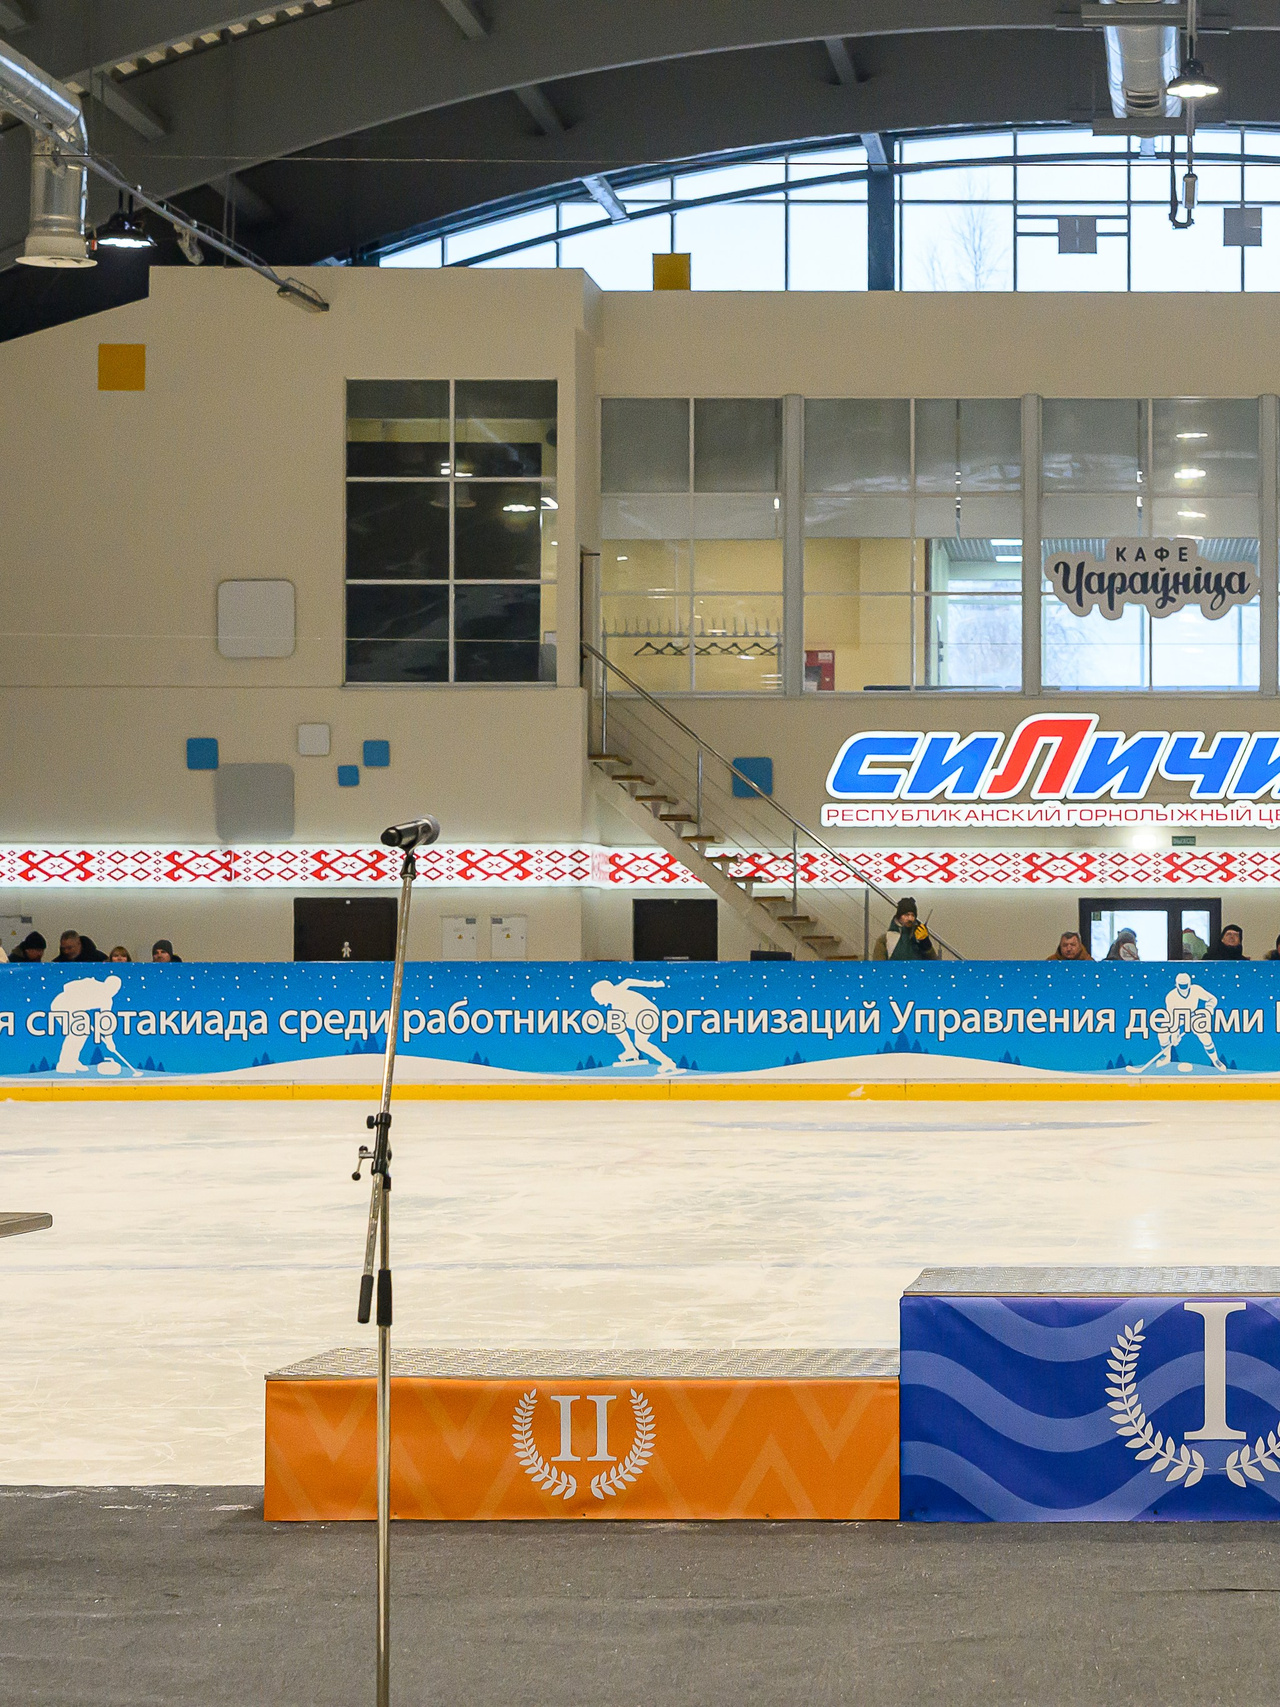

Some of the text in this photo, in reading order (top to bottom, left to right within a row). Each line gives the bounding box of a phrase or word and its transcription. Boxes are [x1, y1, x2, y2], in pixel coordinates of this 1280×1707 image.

[1115, 546, 1189, 563] КАФЕ
[1053, 561, 1251, 612] Чараўніца
[826, 806, 1061, 822] РЕСПУБЛИКАНСКИЙ
[1066, 806, 1252, 822] ГОРНОЛЫЖНЫЙ
[26, 1009, 268, 1042] спартакиада
[288, 1009, 390, 1042] среди
[402, 1000, 626, 1042] работников
[635, 1001, 880, 1042] организаций
[889, 1001, 1115, 1042] Управления
[1124, 1008, 1264, 1040] делами
[1183, 1302, 1248, 1441] I
[550, 1394, 618, 1462] II
